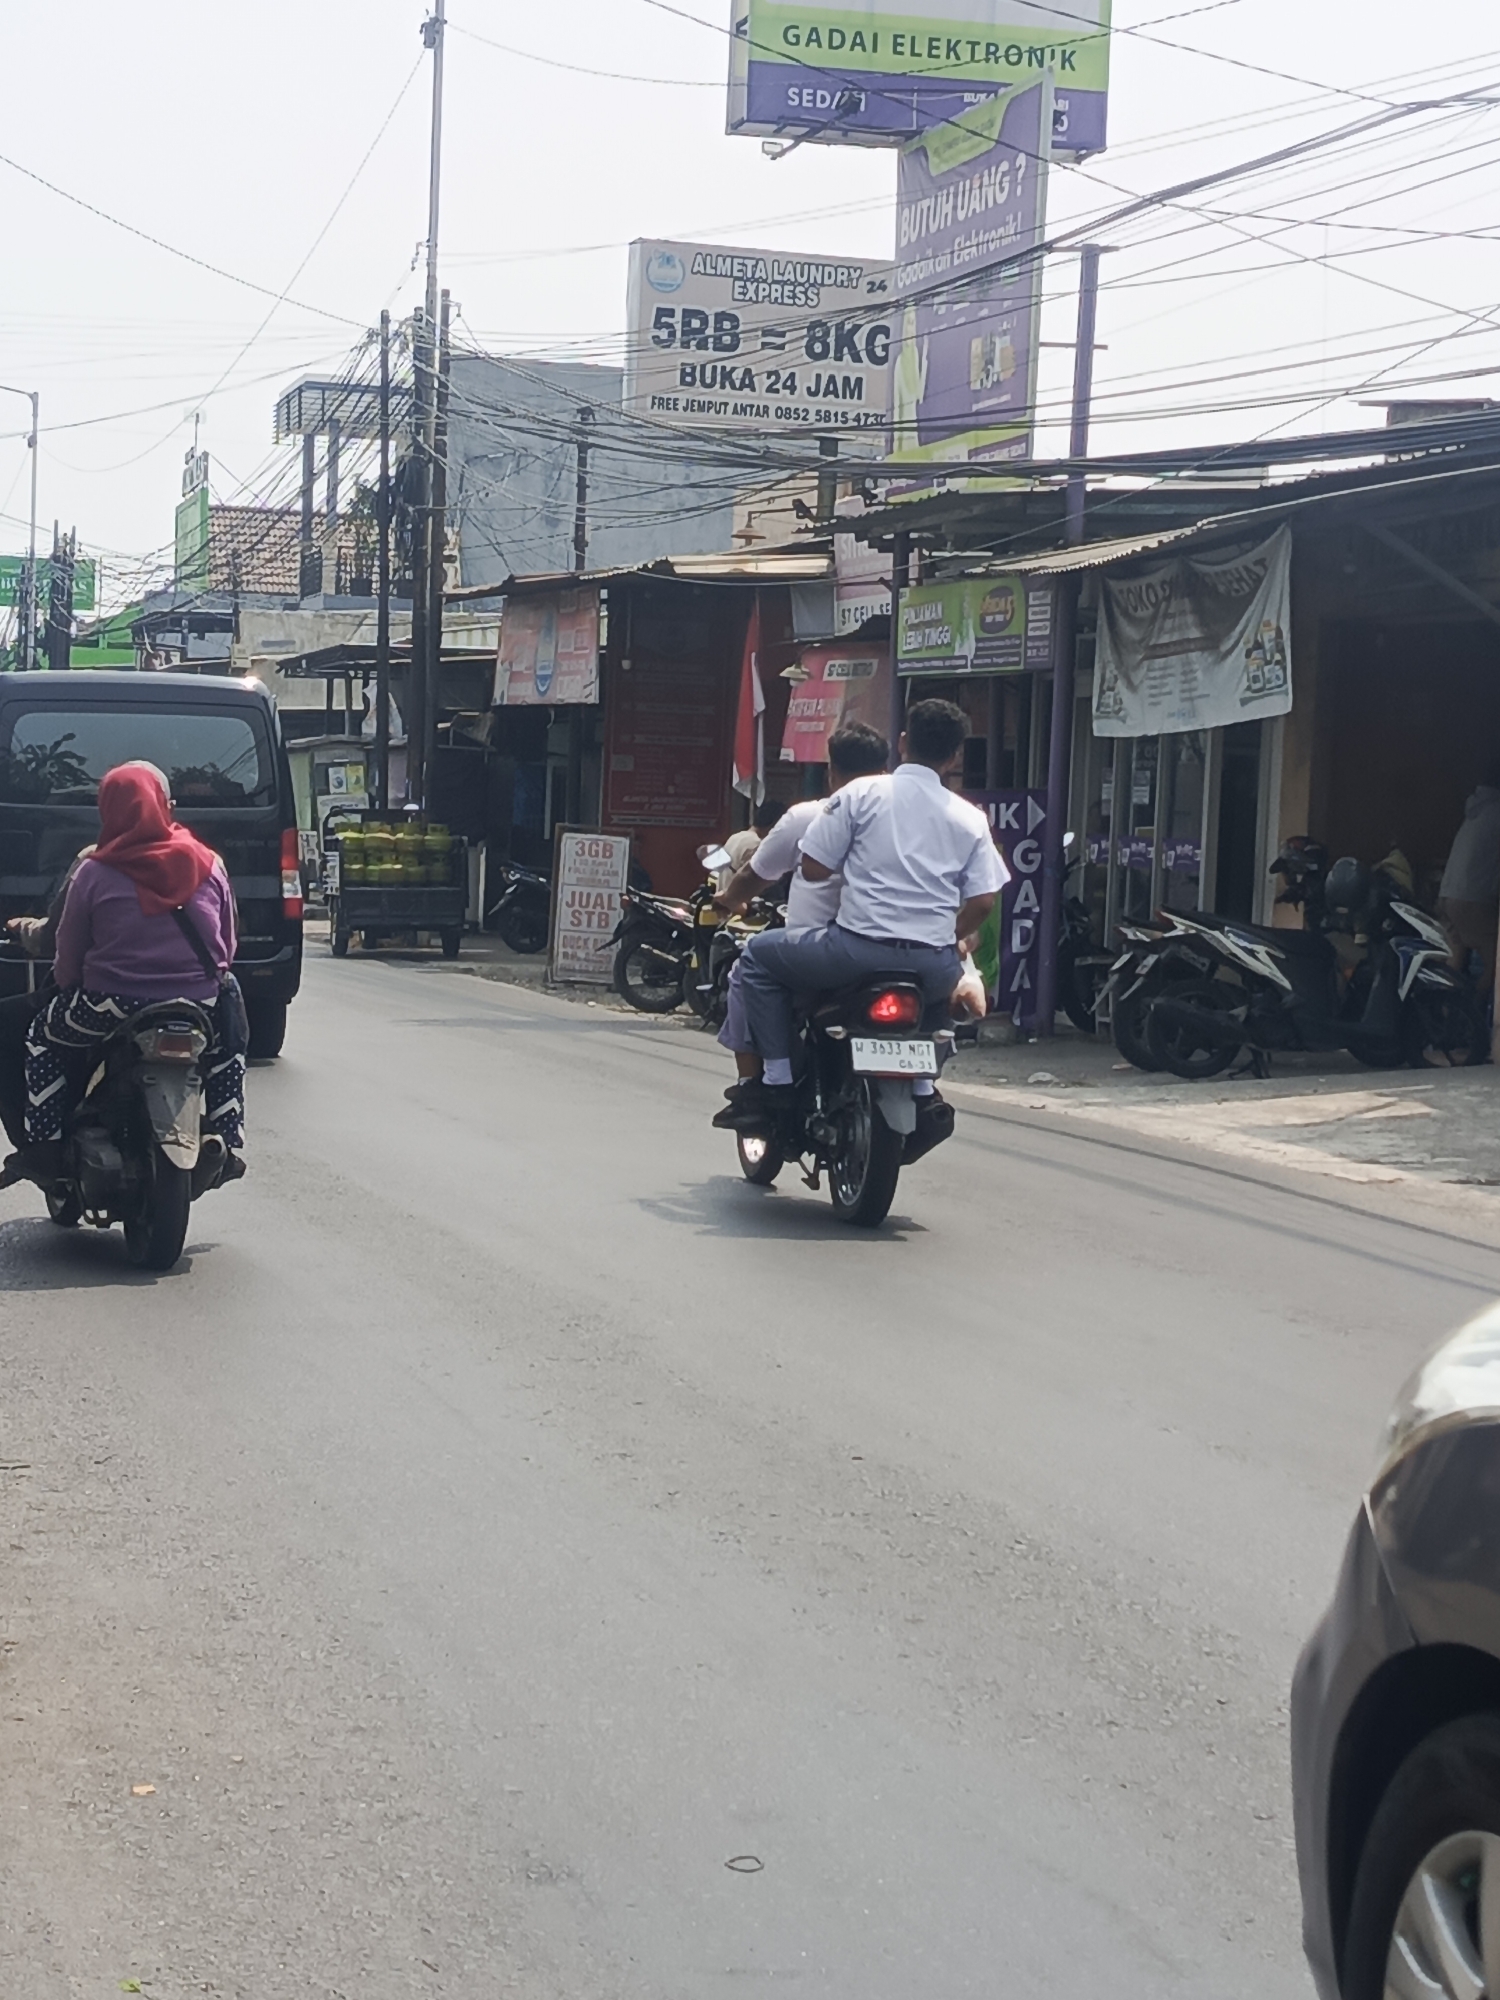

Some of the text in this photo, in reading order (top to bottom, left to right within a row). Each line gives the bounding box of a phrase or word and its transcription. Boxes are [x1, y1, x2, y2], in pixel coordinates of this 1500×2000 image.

[783, 25, 1077, 72] GADAI ELEKTRONIK
[901, 185, 953, 247] BUTUH
[957, 165, 1009, 222] UANG
[691, 253, 863, 289] ALMETA LAUNDRY
[732, 280, 820, 308] EXPRESS
[866, 281, 887, 293] 24
[652, 307, 740, 352] 5RB
[805, 320, 890, 365] 8KG
[679, 362, 863, 400] BUKA 24 JAM
[651, 396, 679, 411] FREE
[682, 399, 729, 415] JEMPUT
[732, 402, 770, 419] ANTAR
[775, 407, 809, 422] 0852
[815, 409, 848, 424] 5815
[575, 840, 614, 860] 3GB
[565, 891, 618, 911] JUAL
[570, 909, 610, 929] STB
